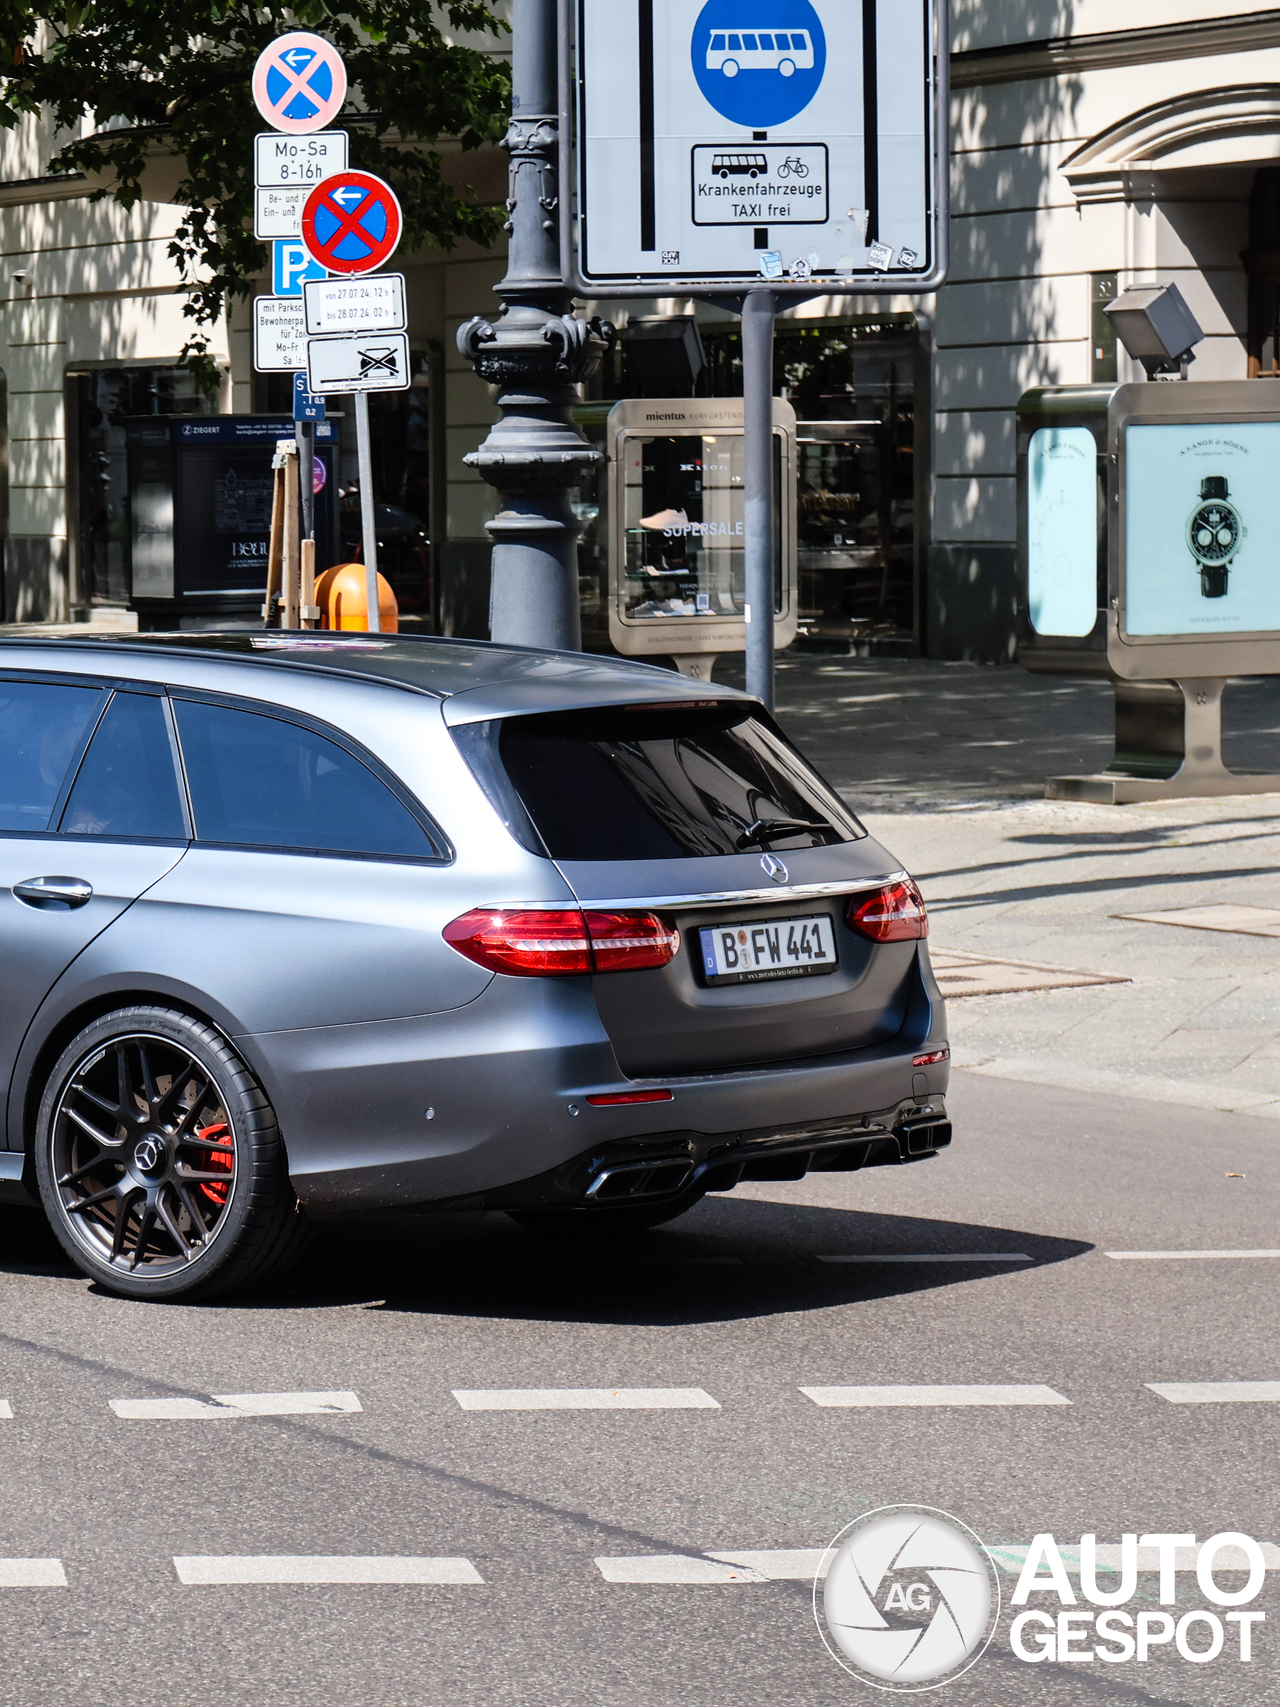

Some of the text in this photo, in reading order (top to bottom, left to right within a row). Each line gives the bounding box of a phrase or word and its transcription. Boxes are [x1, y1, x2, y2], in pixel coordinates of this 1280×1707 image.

[275, 141, 327, 157] Mo-Sa
[280, 163, 322, 179] 8-16h
[698, 182, 822, 198] Krankenfahrzeuge
[269, 193, 282, 203] Be-
[285, 193, 299, 203] und
[264, 205, 296, 217] Ein- und
[731, 203, 791, 217] TAXI frei
[873, 244, 888, 255] DOPE
[870, 256, 885, 266] DOPE
[325, 292, 336, 300] von
[374, 287, 383, 297] 12
[385, 289, 389, 297] h
[263, 302, 304, 313] mit Parksc
[326, 311, 336, 320] bis
[373, 307, 383, 317] 02
[385, 309, 389, 317] h
[280, 329, 291, 339] für
[276, 342, 299, 352] Mo-Fr
[283, 355, 292, 365] Sa
[314, 396, 325, 405] 0.9
[305, 408, 316, 416] 0.2
[646, 411, 686, 421] mientus
[193, 426, 220, 434] ZIEGERT
[663, 521, 744, 537] SUPERSALE
[707, 923, 827, 969] D B FW 441
[748, 968, 804, 979] www.mercedes-benz-berlin.de
[157, 1020, 183, 1036] Sport
